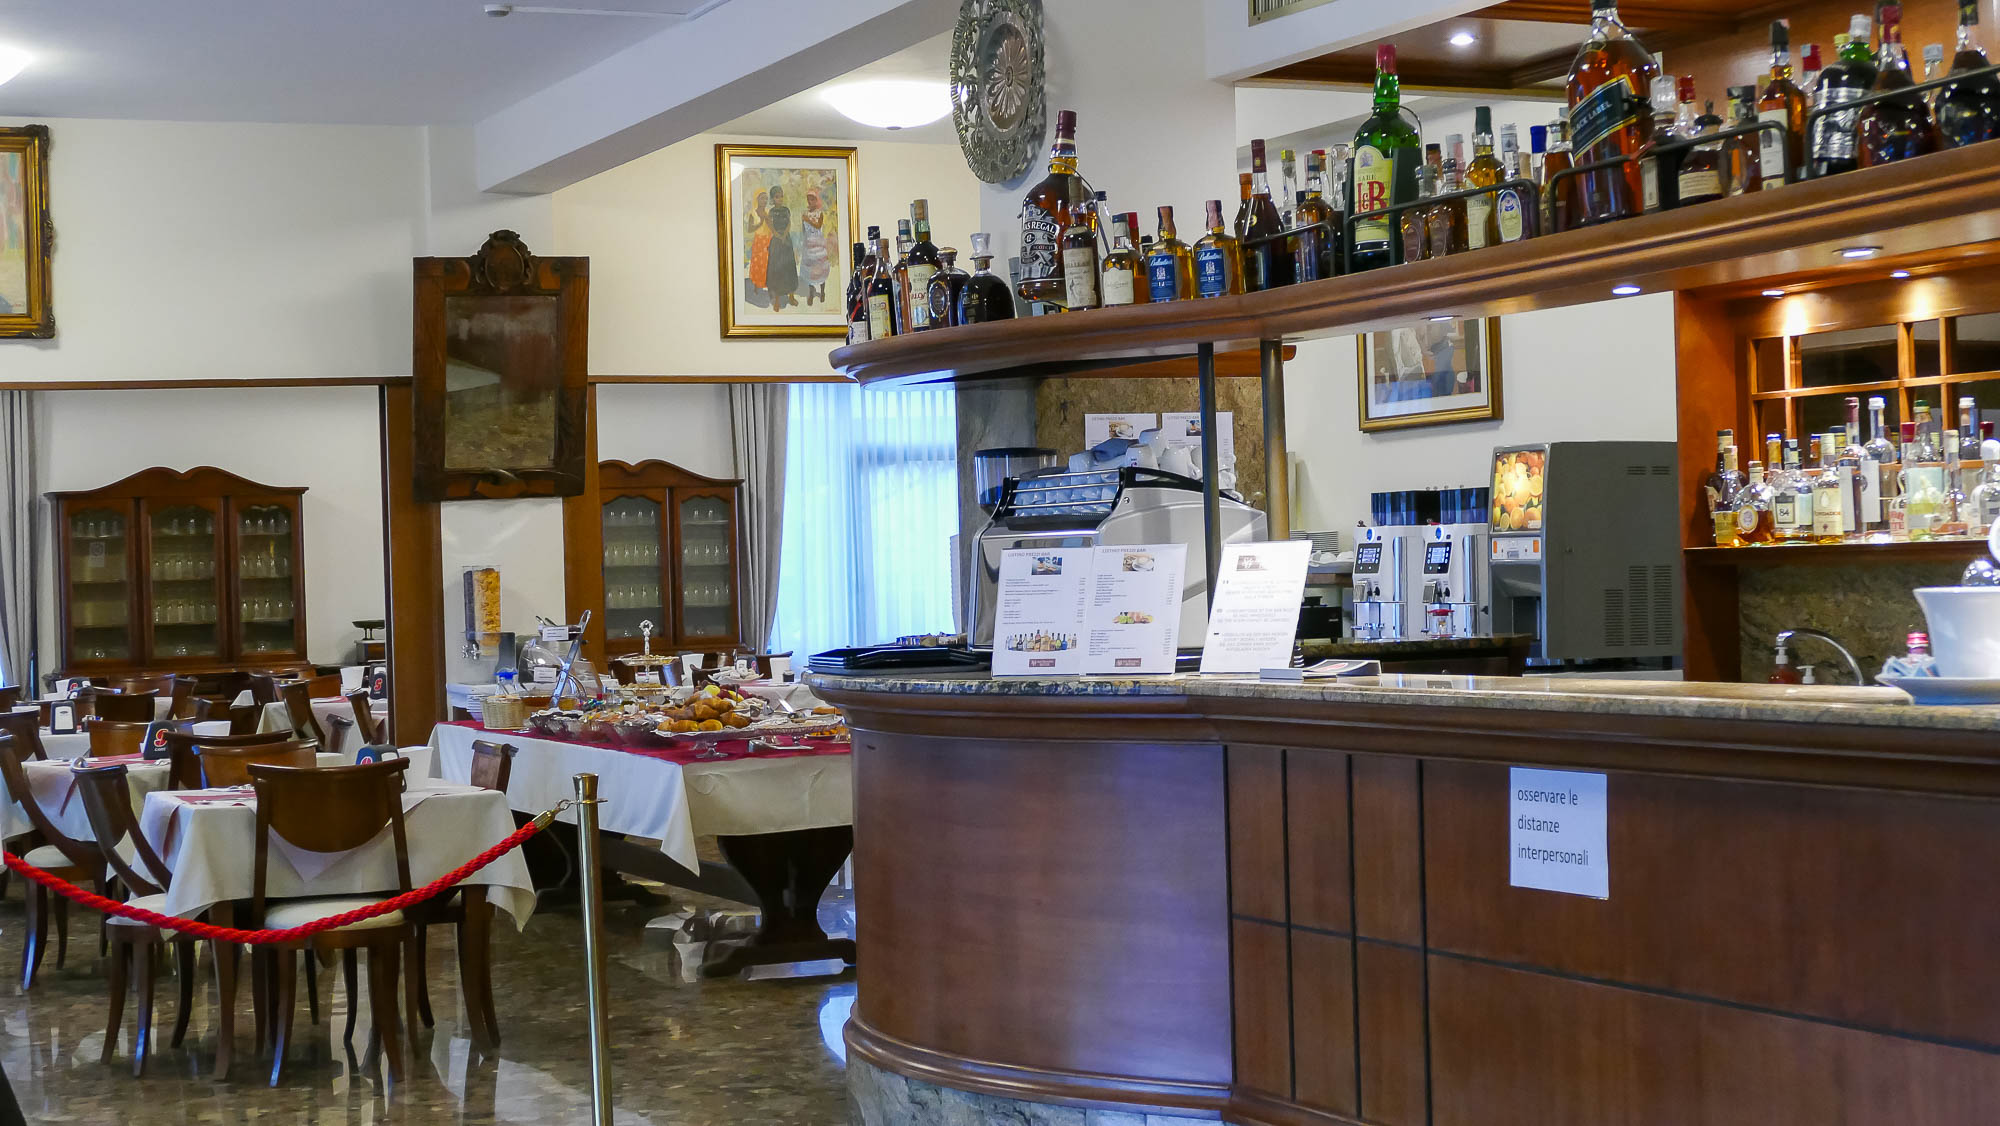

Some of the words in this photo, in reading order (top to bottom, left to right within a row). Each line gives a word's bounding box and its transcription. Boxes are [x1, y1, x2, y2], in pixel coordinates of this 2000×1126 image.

[1031, 221, 1056, 234] REGAL
[1779, 508, 1790, 517] 84
[1517, 789, 1566, 805] osservare
[1569, 788, 1578, 805] le
[1517, 814, 1560, 834] distanze
[1518, 843, 1589, 866] interpersonali
